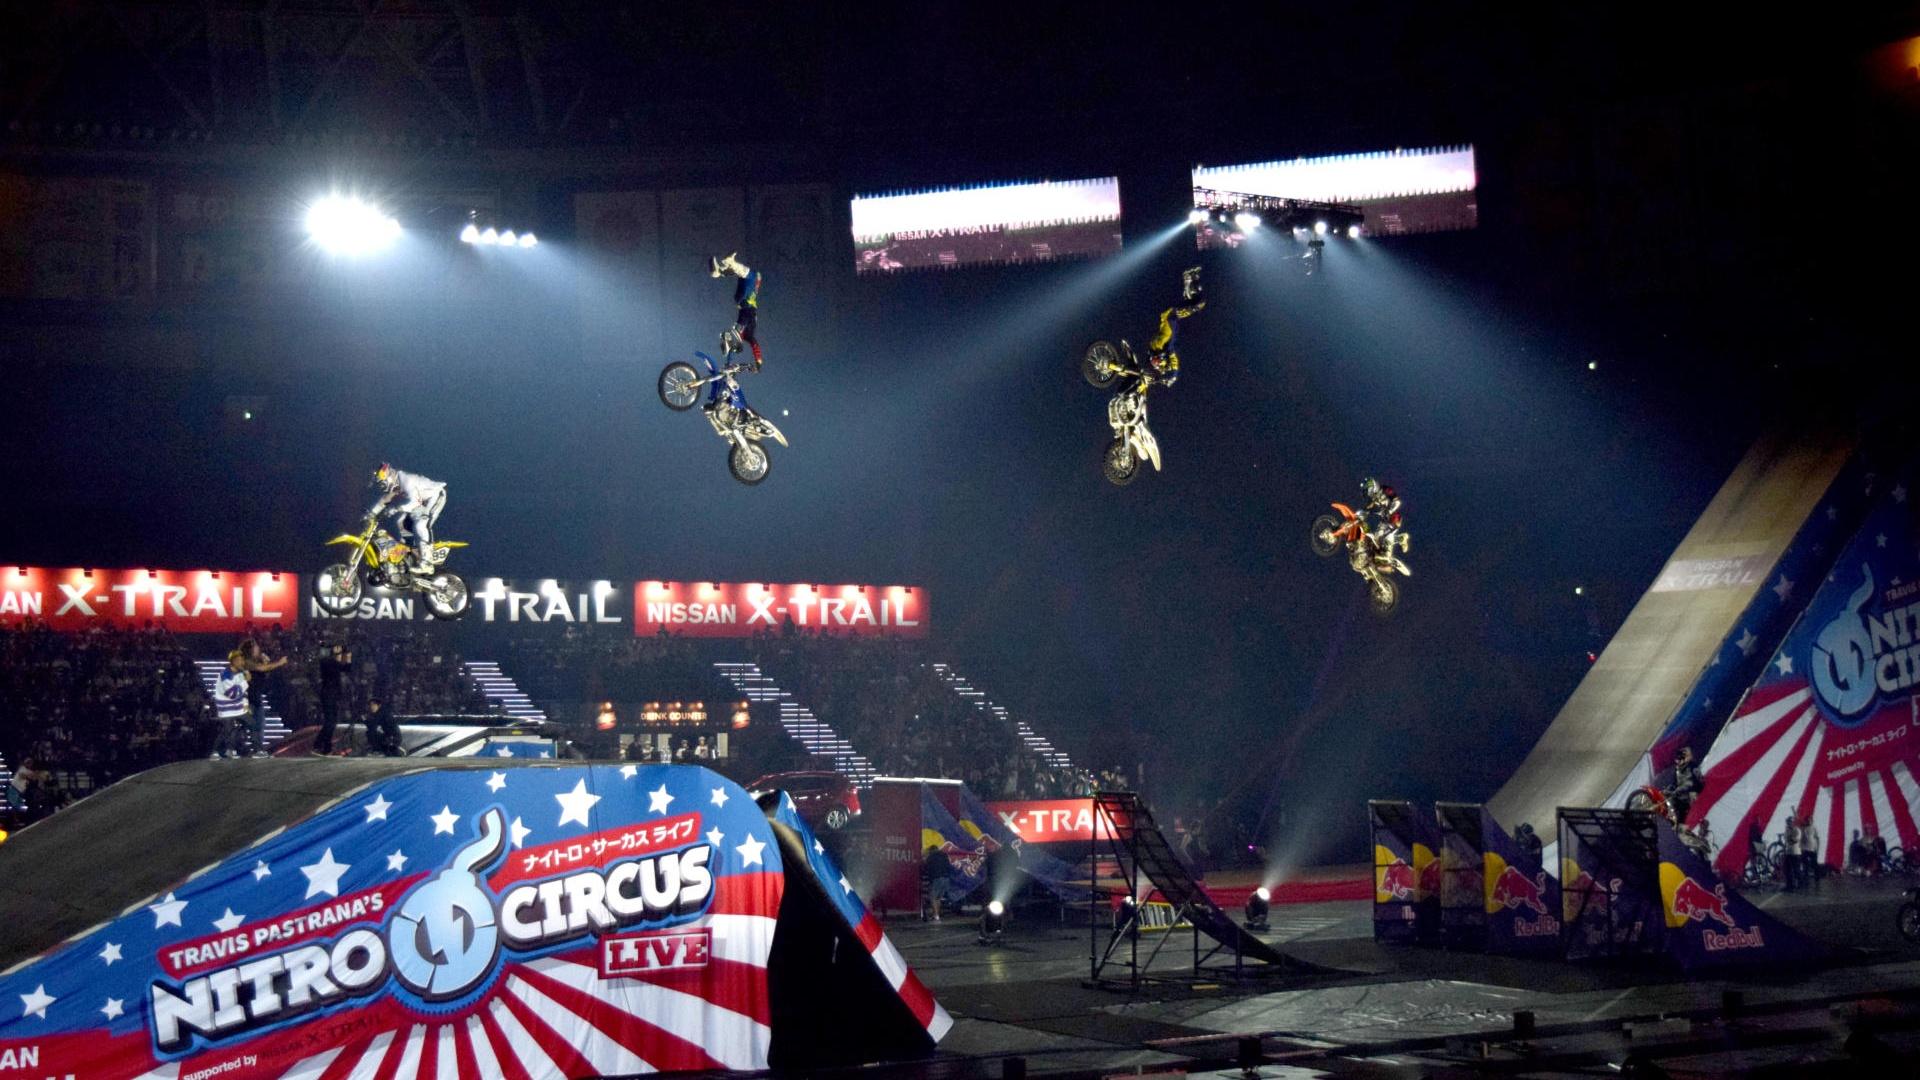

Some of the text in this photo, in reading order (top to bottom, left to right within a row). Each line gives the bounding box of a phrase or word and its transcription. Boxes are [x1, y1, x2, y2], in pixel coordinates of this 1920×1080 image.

[55, 584, 283, 618] X-TRAIL
[647, 597, 919, 626] NISSAN X-TRAIL
[669, 711, 707, 721] COUNTER
[501, 845, 713, 940] CIRCUS
[169, 892, 384, 970] TRAVIS PASTRANA'S
[609, 935, 708, 971] LIVE
[152, 929, 386, 1045] NITRO
[183, 1059, 242, 1080] supported
[243, 1053, 258, 1070] by
